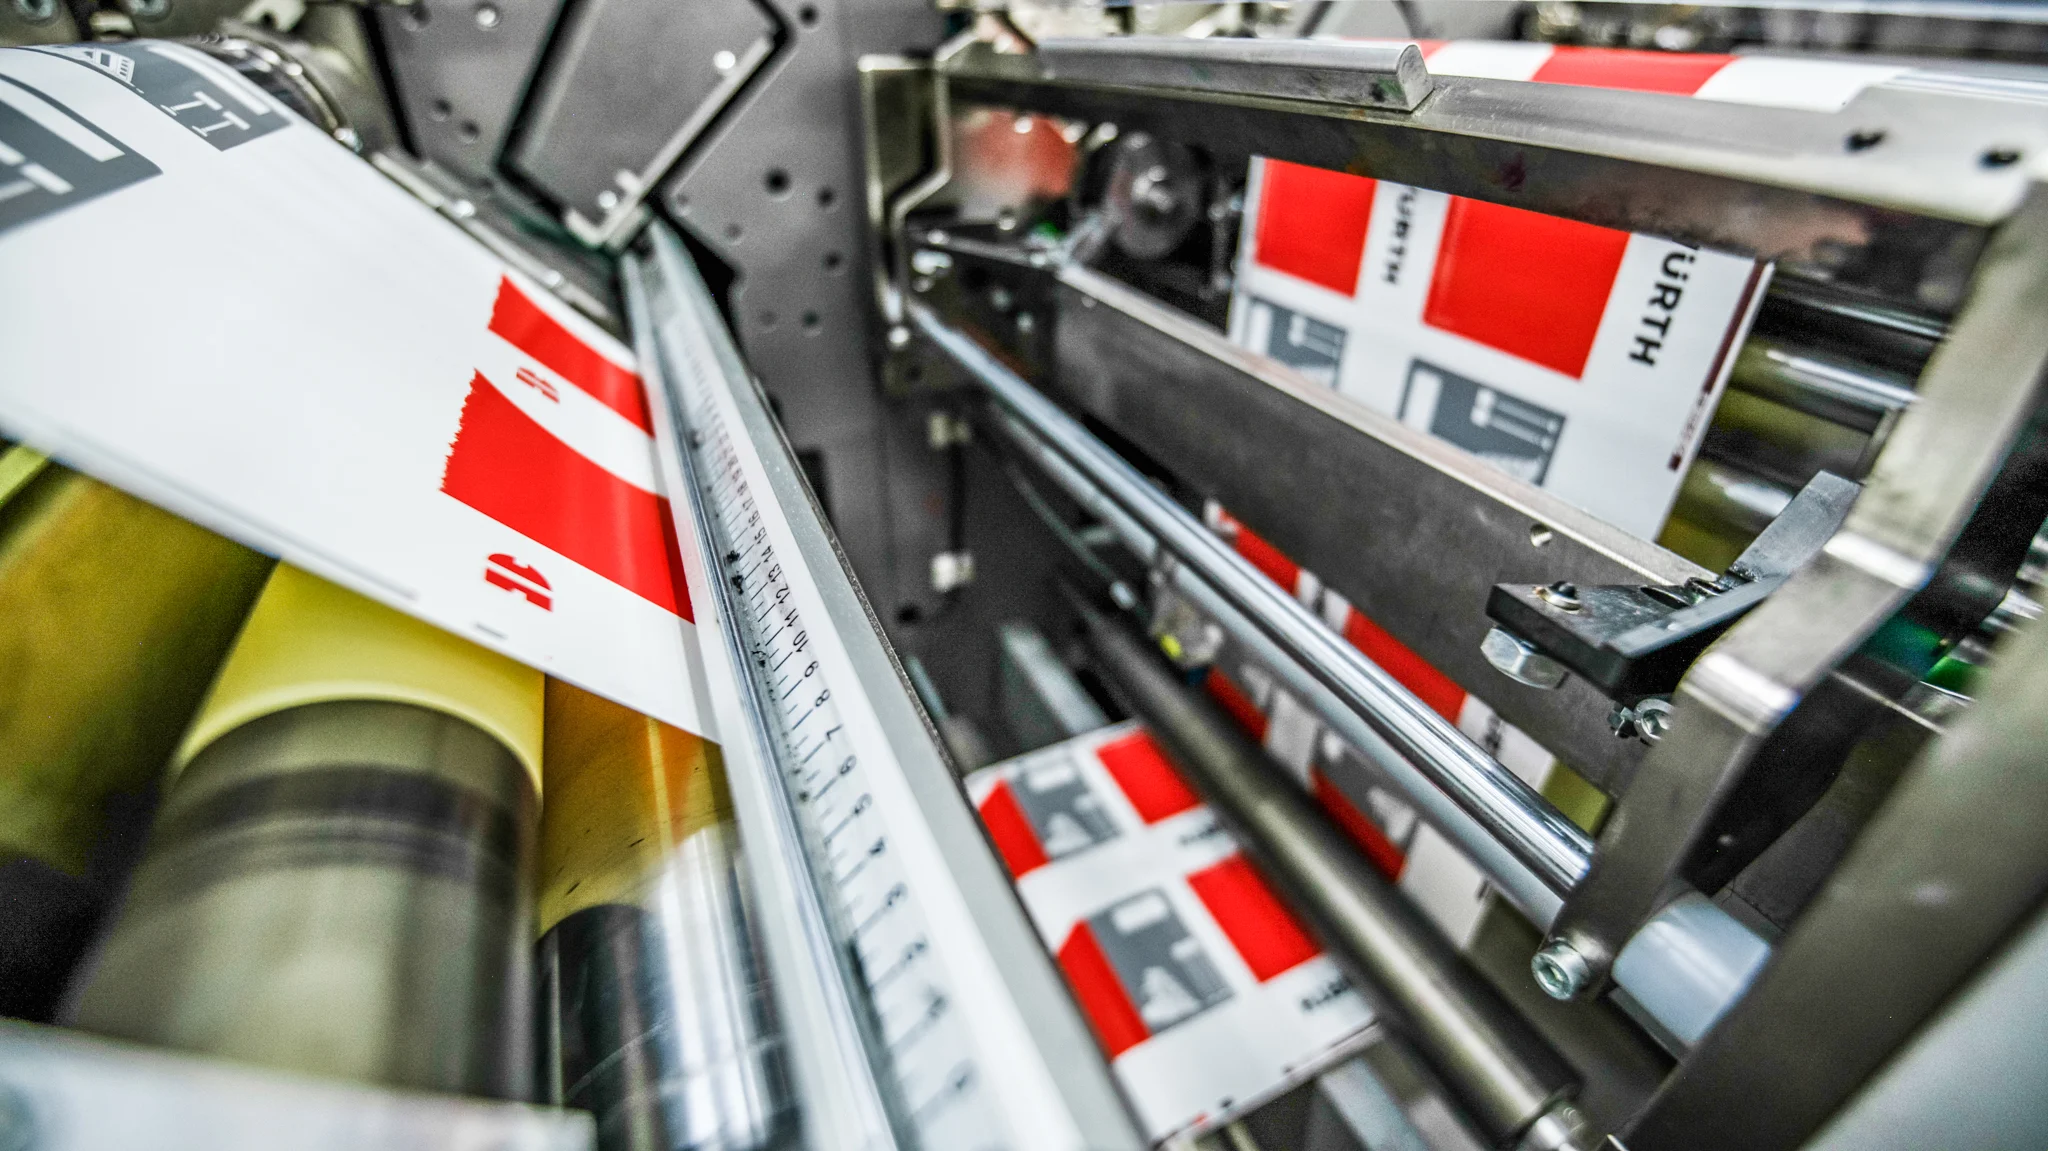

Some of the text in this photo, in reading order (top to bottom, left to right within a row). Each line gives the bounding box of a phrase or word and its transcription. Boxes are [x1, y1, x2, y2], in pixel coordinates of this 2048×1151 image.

[1628, 246, 1699, 366] ÜRTH
[737, 480, 749, 496] 18
[742, 497, 754, 511] 17
[748, 510, 760, 527] 16
[754, 526, 767, 545] 15
[761, 545, 774, 563] 14
[768, 563, 782, 583] 13
[776, 583, 790, 604] 12
[784, 608, 799, 627] 11
[793, 630, 809, 652] 10
[804, 661, 819, 677] 9
[816, 689, 830, 707] 8
[827, 724, 843, 741] 7
[840, 755, 856, 774] 6
[854, 793, 872, 815] 5
